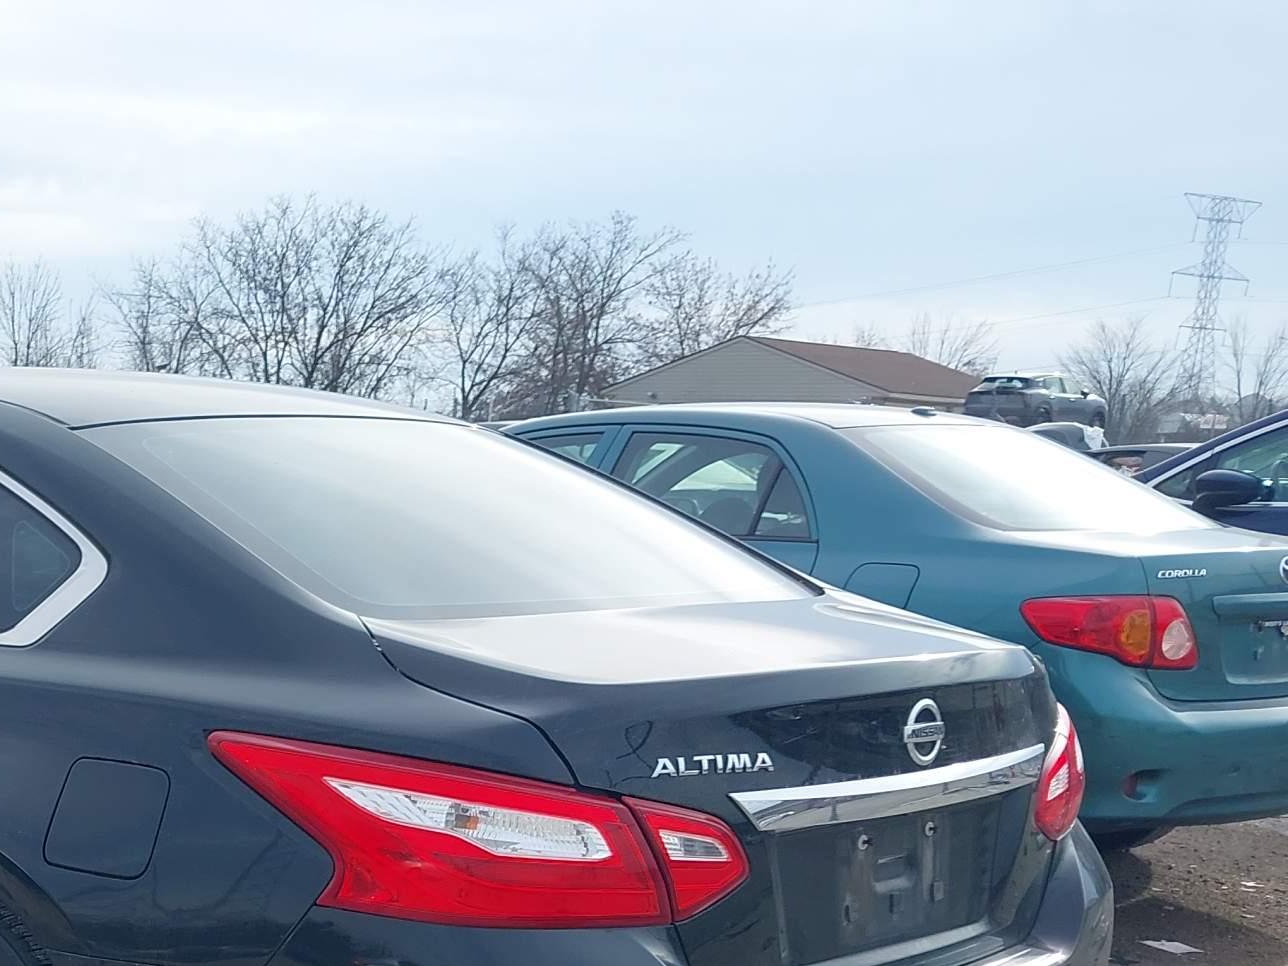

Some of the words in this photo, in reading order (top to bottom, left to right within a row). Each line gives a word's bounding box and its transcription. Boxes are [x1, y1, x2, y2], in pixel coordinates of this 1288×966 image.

[1157, 568, 1207, 579] COROLLA
[906, 725, 944, 739] NISSAN
[650, 752, 774, 778] ALTIMA
